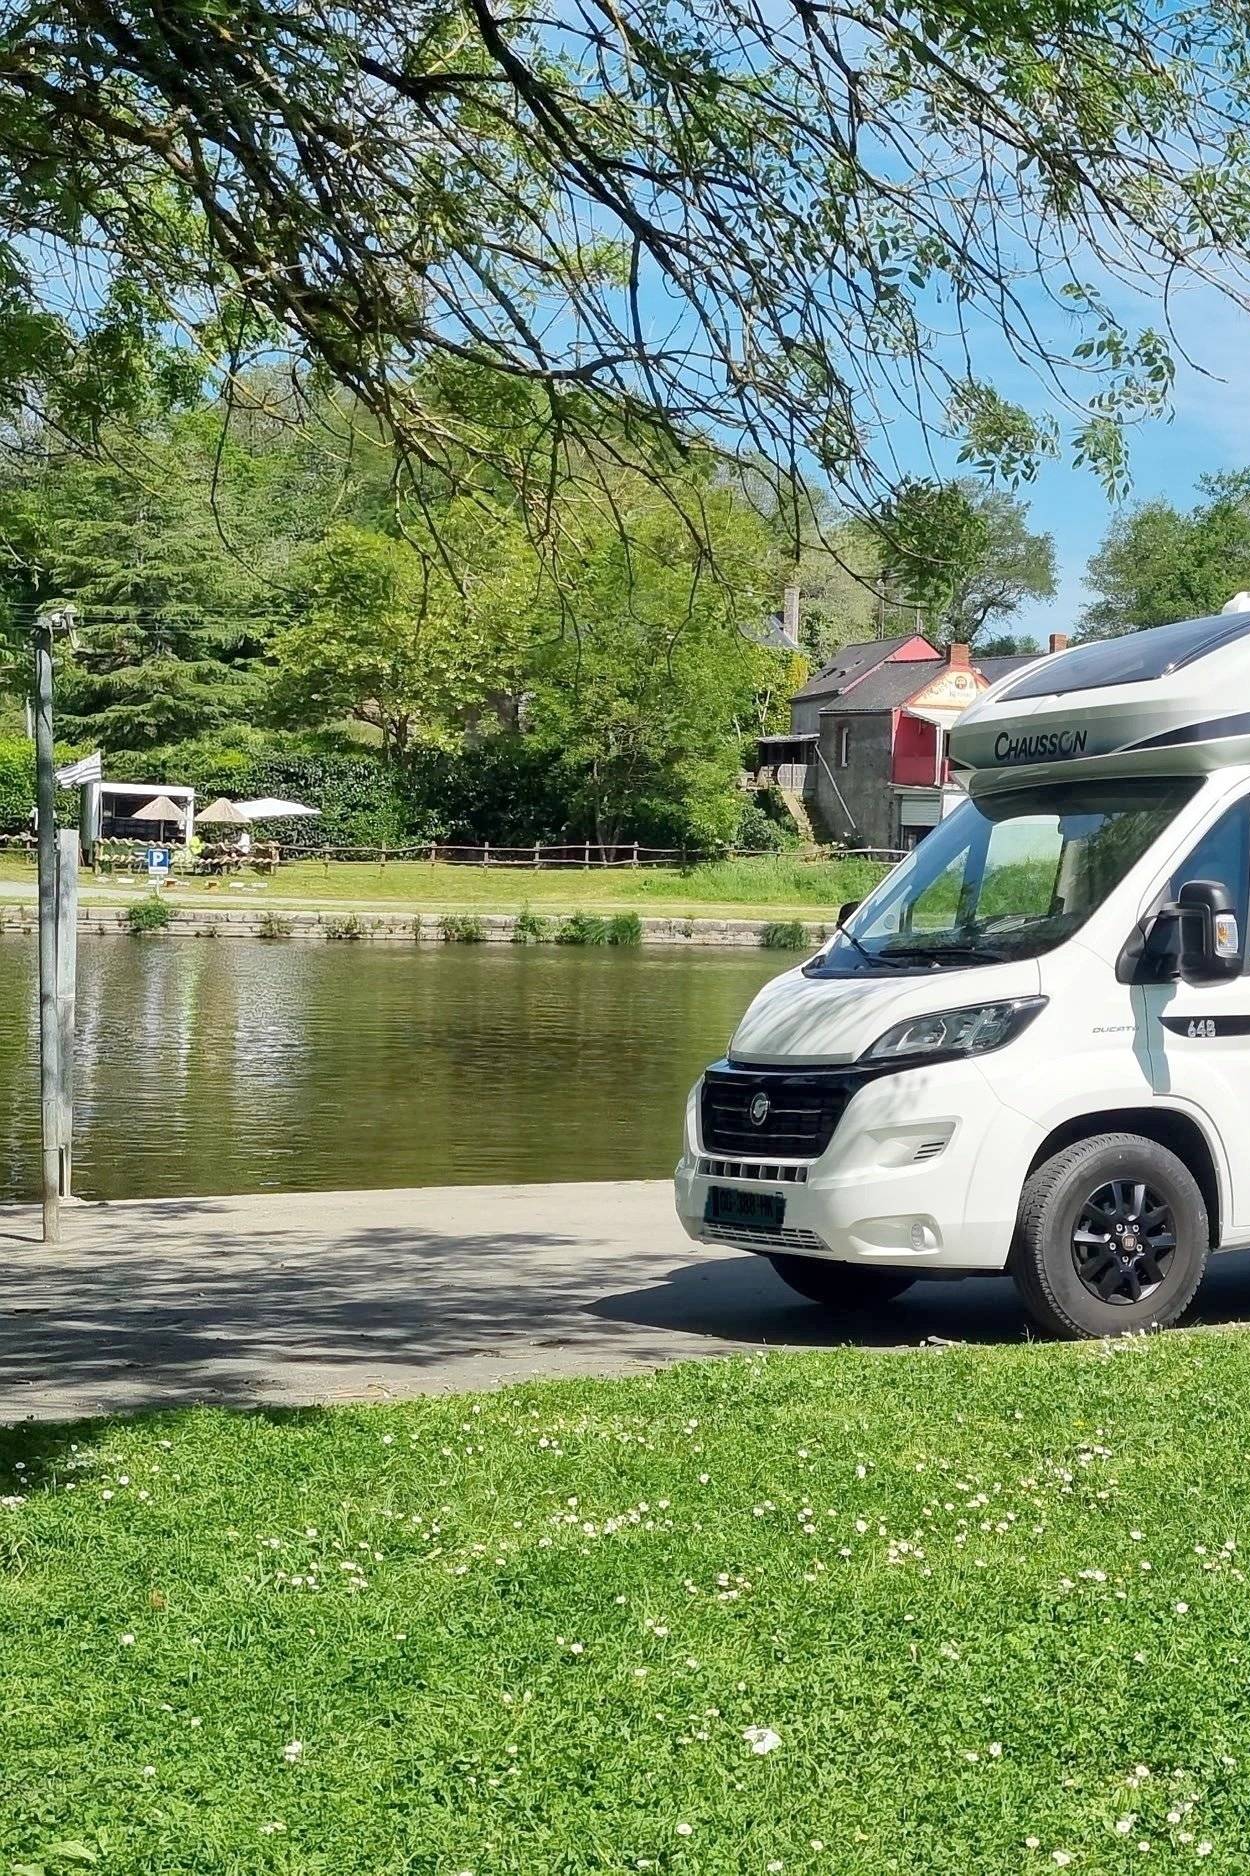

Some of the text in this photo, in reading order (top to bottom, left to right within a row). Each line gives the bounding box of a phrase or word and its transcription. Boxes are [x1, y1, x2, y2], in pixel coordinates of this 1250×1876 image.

[994, 730, 1088, 760] CHAUSSON
[152, 851, 164, 867] P
[1187, 1019, 1216, 1038] 648
